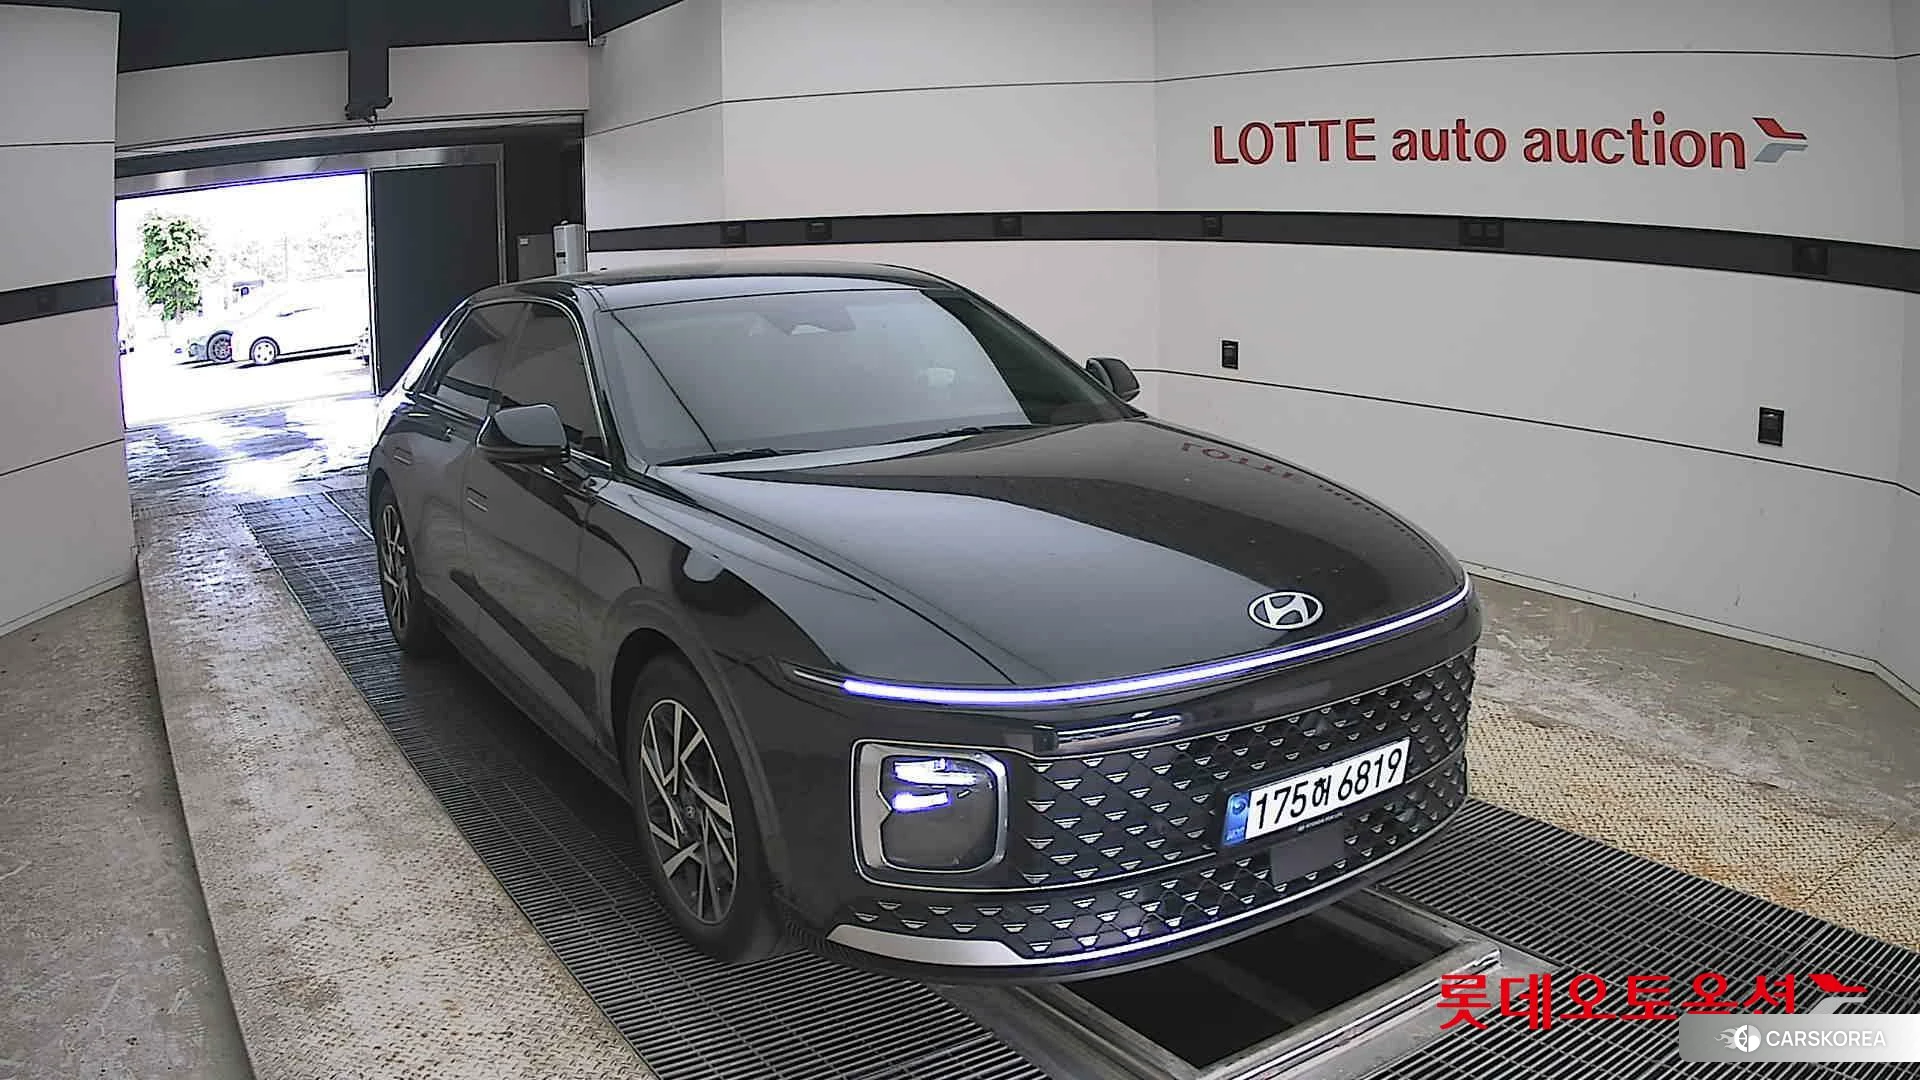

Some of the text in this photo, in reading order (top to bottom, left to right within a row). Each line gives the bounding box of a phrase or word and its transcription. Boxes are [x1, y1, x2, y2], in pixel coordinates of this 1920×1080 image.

[1213, 111, 1747, 170] LOTTE auto auction
[1337, 748, 1403, 801] 6819
